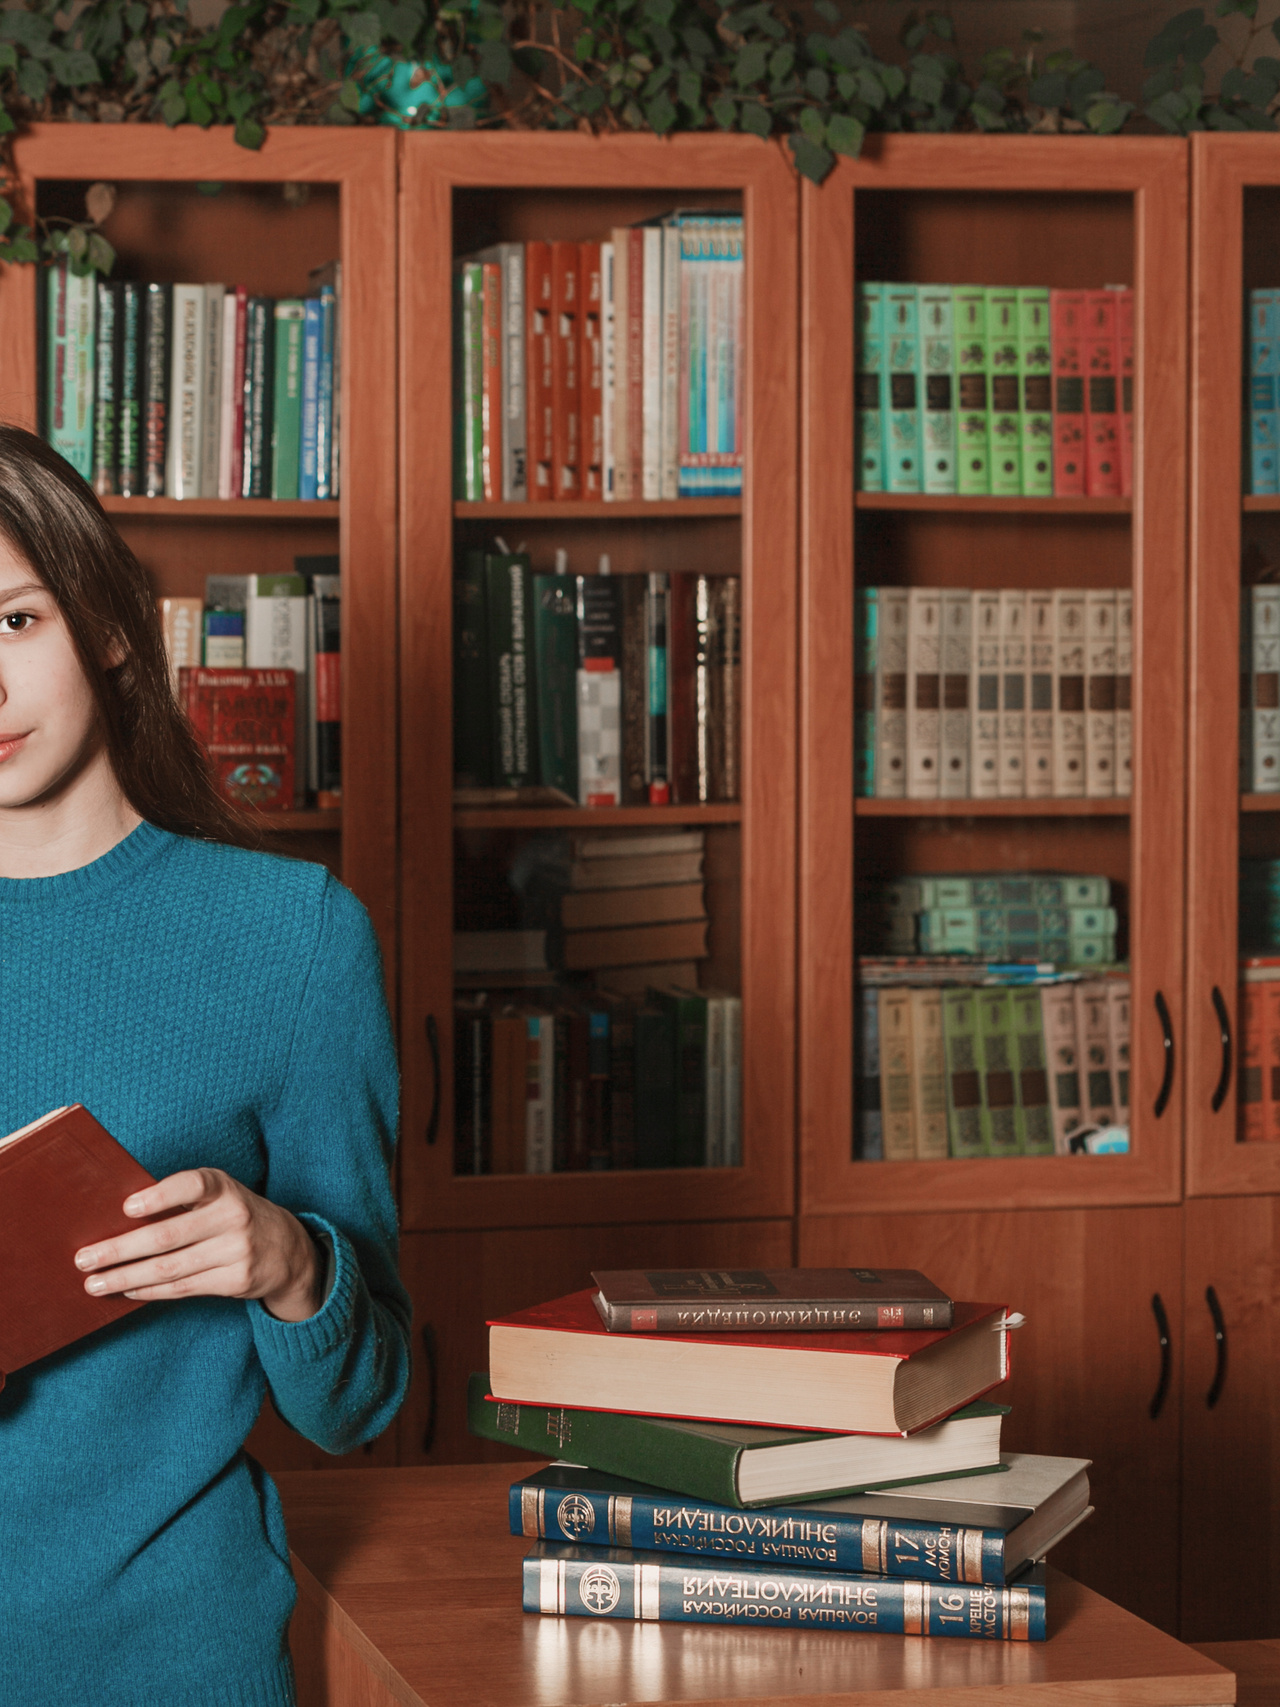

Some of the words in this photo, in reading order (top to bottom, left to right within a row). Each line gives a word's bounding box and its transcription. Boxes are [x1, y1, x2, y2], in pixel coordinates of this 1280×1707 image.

[676, 1307, 862, 1327] ЭНЦИКЛОПЕДИЯ
[653, 1506, 838, 1544] ЭНЦИКЛОПЕДИЯ
[654, 1530, 756, 1555] РОССИЙСКАЯ
[762, 1542, 838, 1563] БОЛЬШАЯ
[894, 1530, 920, 1564] 17
[924, 1538, 938, 1567] ЛАС
[938, 1526, 952, 1580] ЛОМОН
[682, 1575, 879, 1607] ЭНЦИКЛОПЕДИЯ
[683, 1600, 792, 1619] РОССИЙСКАЯ
[798, 1607, 878, 1625] БОЛЬШАЯ
[938, 1593, 965, 1625] 16
[969, 1590, 983, 1634] КРЕЩЕ
